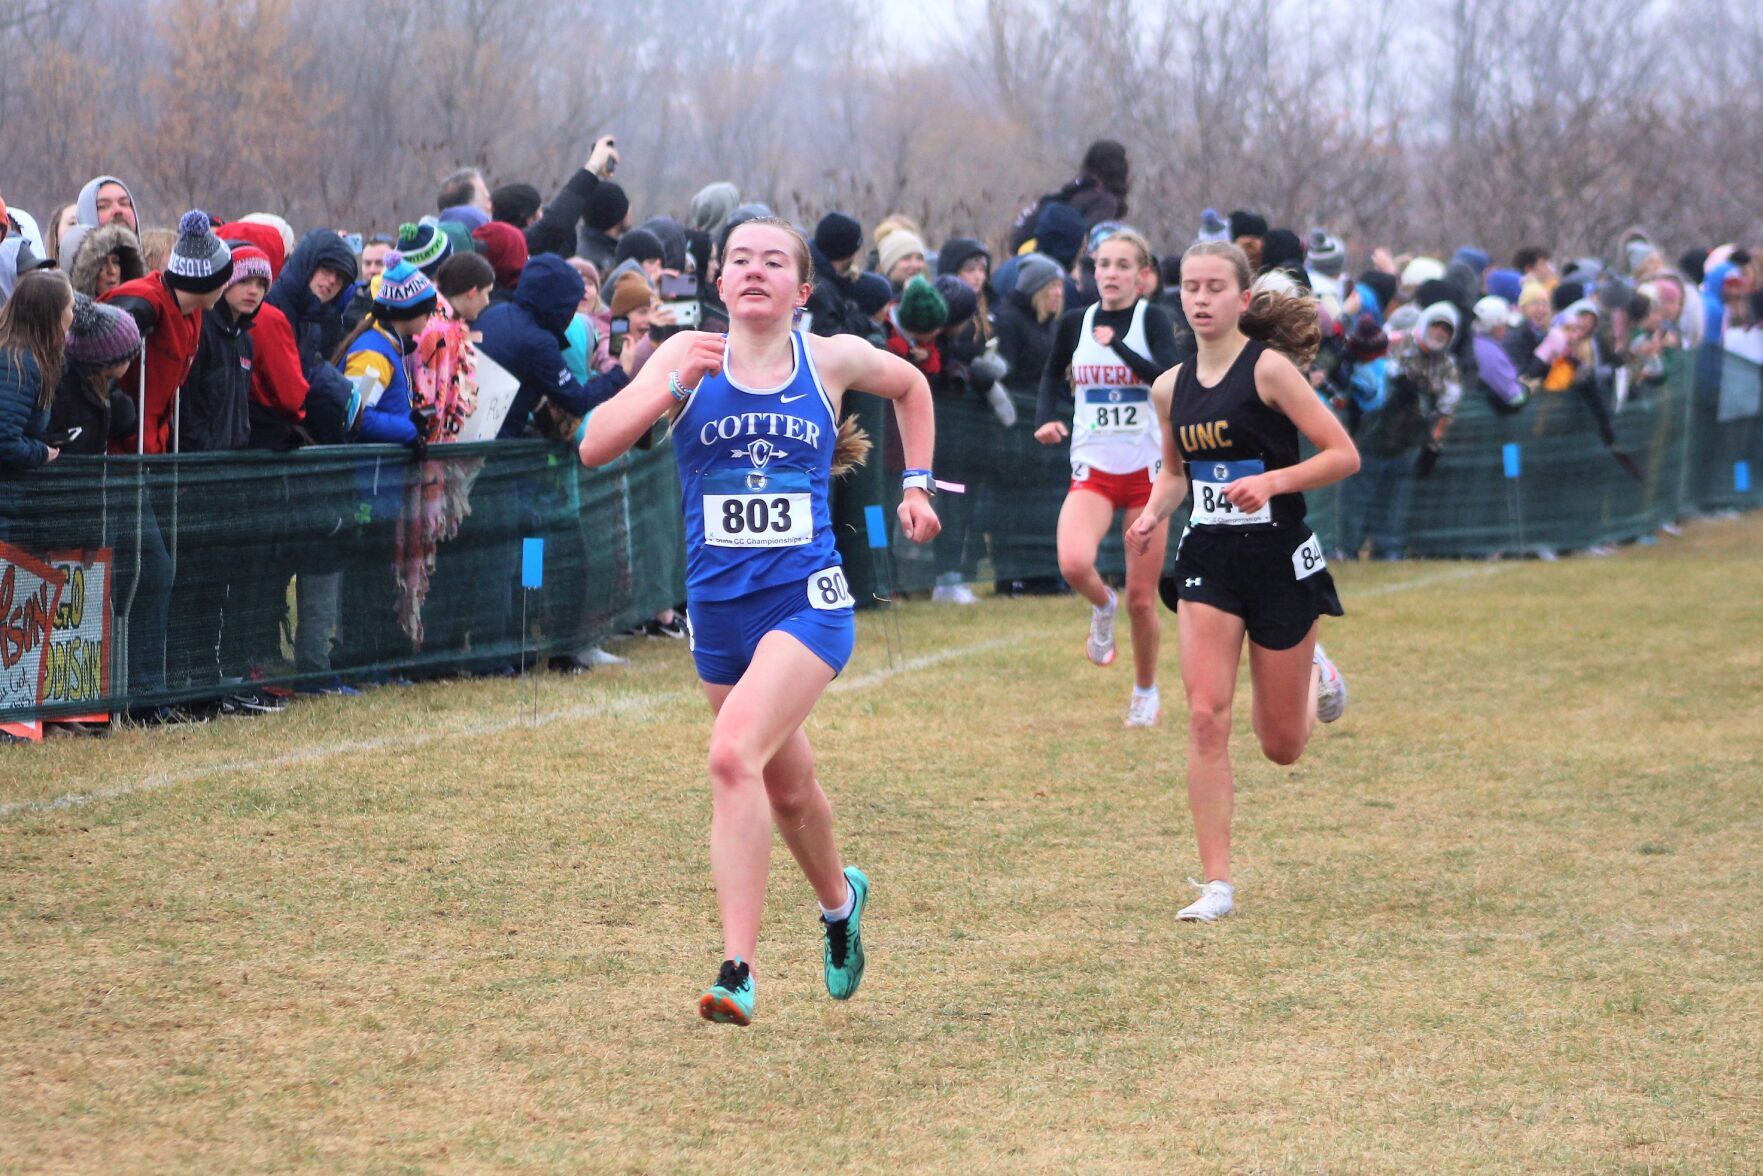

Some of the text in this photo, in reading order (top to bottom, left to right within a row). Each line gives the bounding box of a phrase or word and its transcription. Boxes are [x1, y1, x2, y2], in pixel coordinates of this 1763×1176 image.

[168, 253, 213, 278] ESOTA
[700, 412, 820, 450] COTTER
[1097, 405, 1137, 427] 812
[1179, 420, 1233, 452] UNC
[1202, 485, 1246, 513] 84
[722, 498, 792, 533] 803
[817, 572, 849, 604] 80
